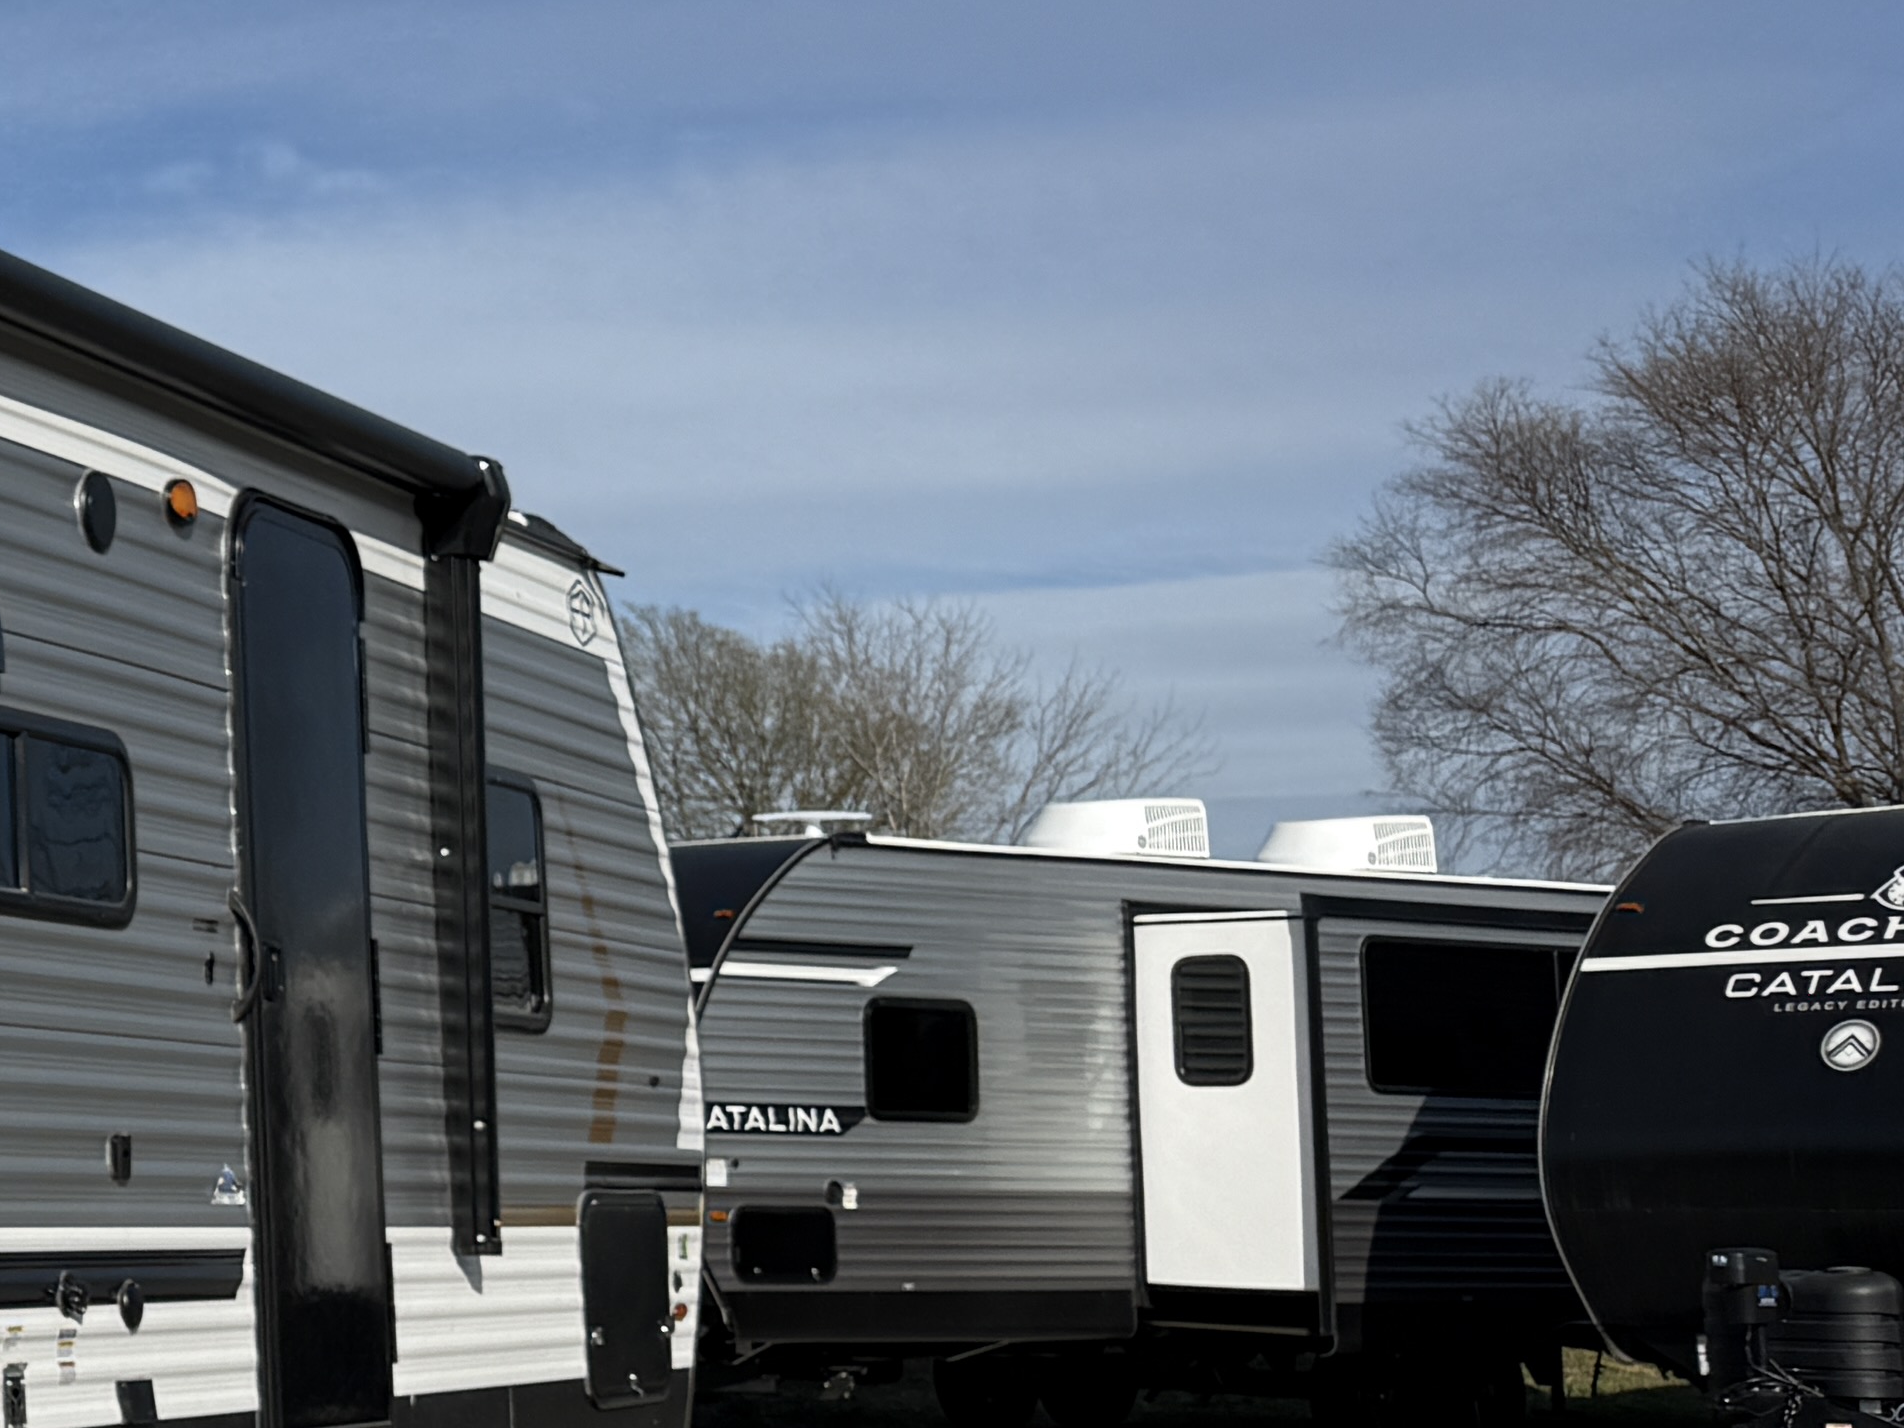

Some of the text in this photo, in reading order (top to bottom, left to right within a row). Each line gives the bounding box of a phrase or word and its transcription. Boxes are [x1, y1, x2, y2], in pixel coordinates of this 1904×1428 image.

[1724, 966, 1900, 999] CATAL
[1773, 1000, 1848, 1013] LEGACY
[705, 1104, 842, 1134] ATALINA
